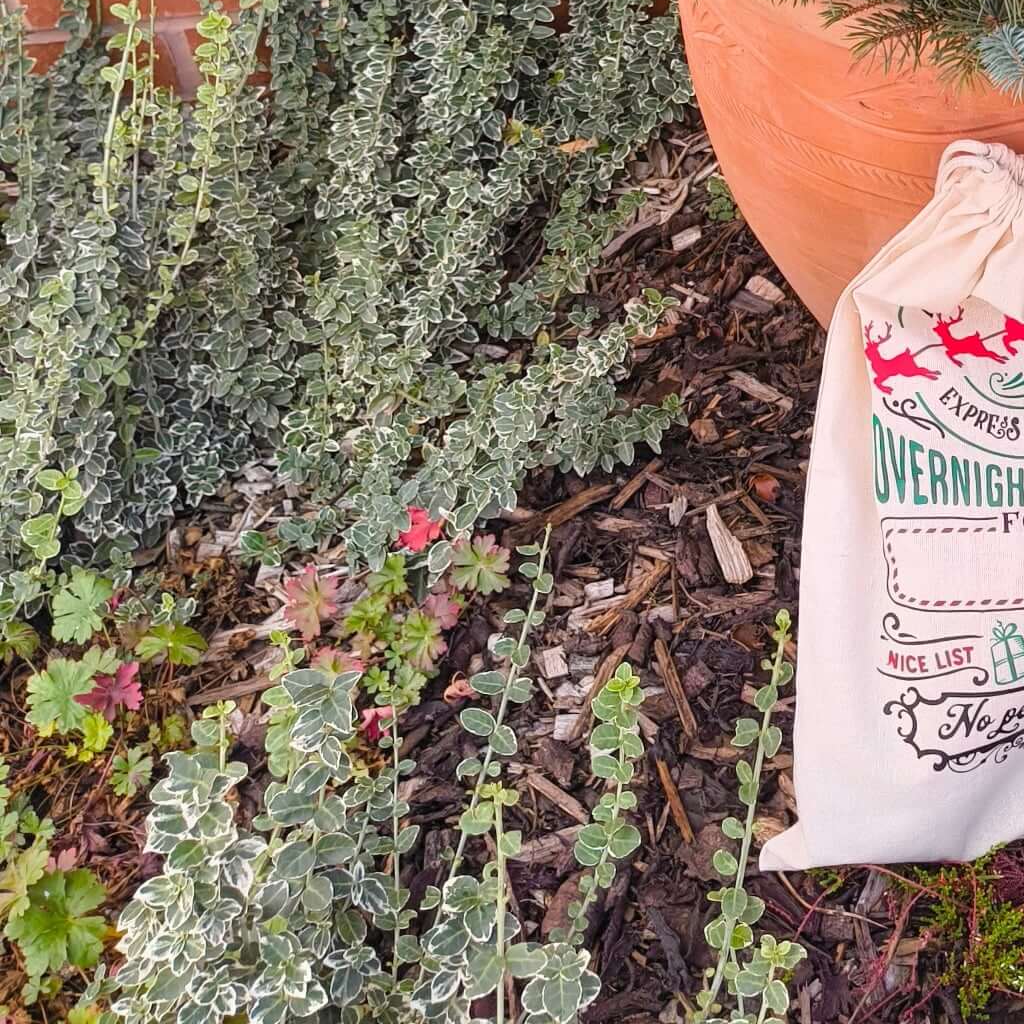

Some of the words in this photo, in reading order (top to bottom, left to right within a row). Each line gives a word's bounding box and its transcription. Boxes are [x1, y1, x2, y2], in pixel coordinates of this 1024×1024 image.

[939, 386, 1021, 441] EXPRESS
[887, 649, 929, 674] NICE
[935, 646, 974, 670] LIST
[938, 697, 997, 740] No
